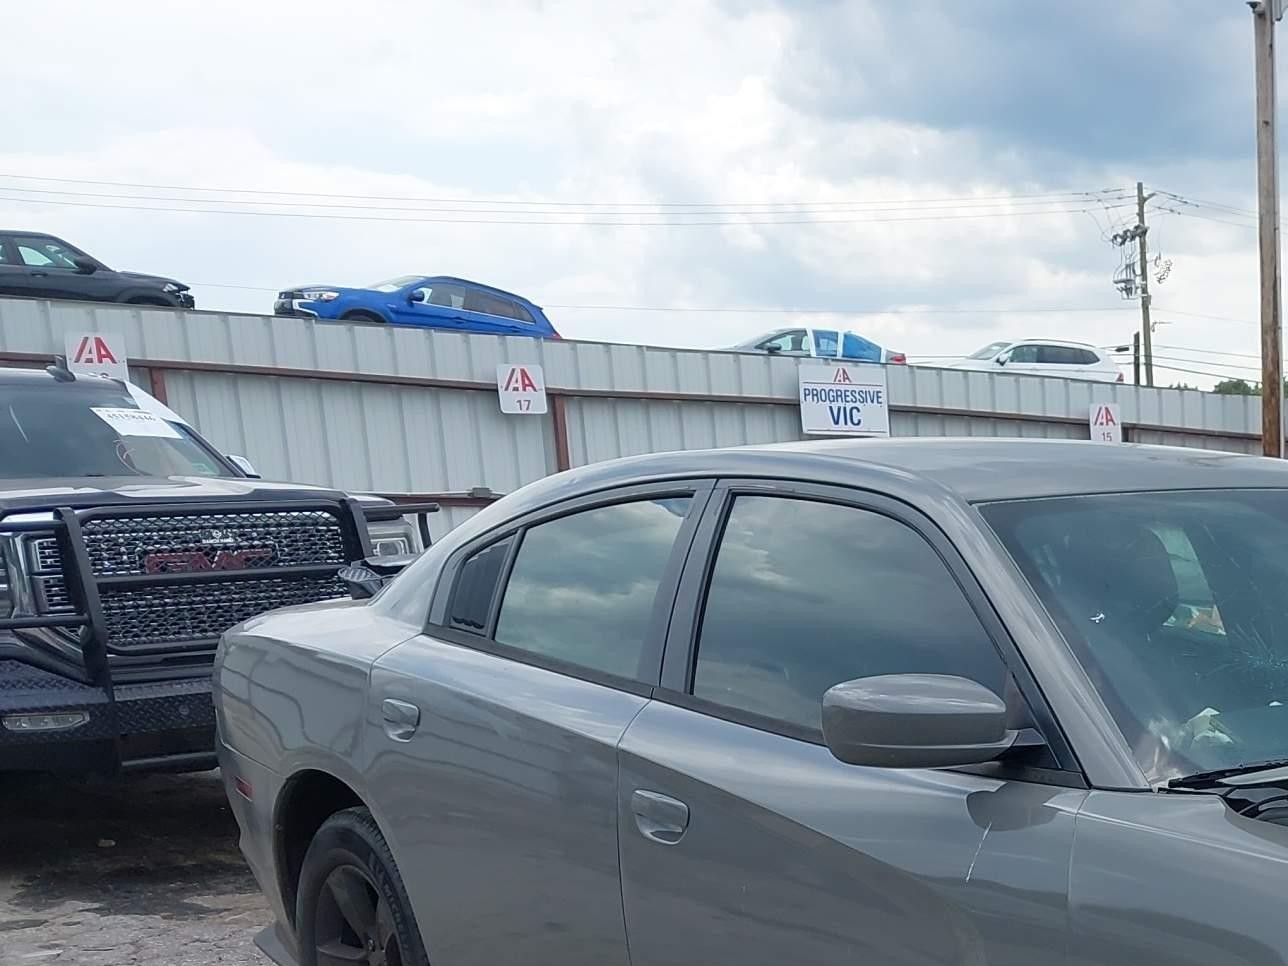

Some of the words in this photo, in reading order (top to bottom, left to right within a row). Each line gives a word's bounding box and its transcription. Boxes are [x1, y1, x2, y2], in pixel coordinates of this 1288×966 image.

[516, 399, 532, 411] 17
[803, 388, 883, 405] PROGRESSIVE
[828, 405, 862, 426] VIC
[145, 548, 272, 574] GMC
